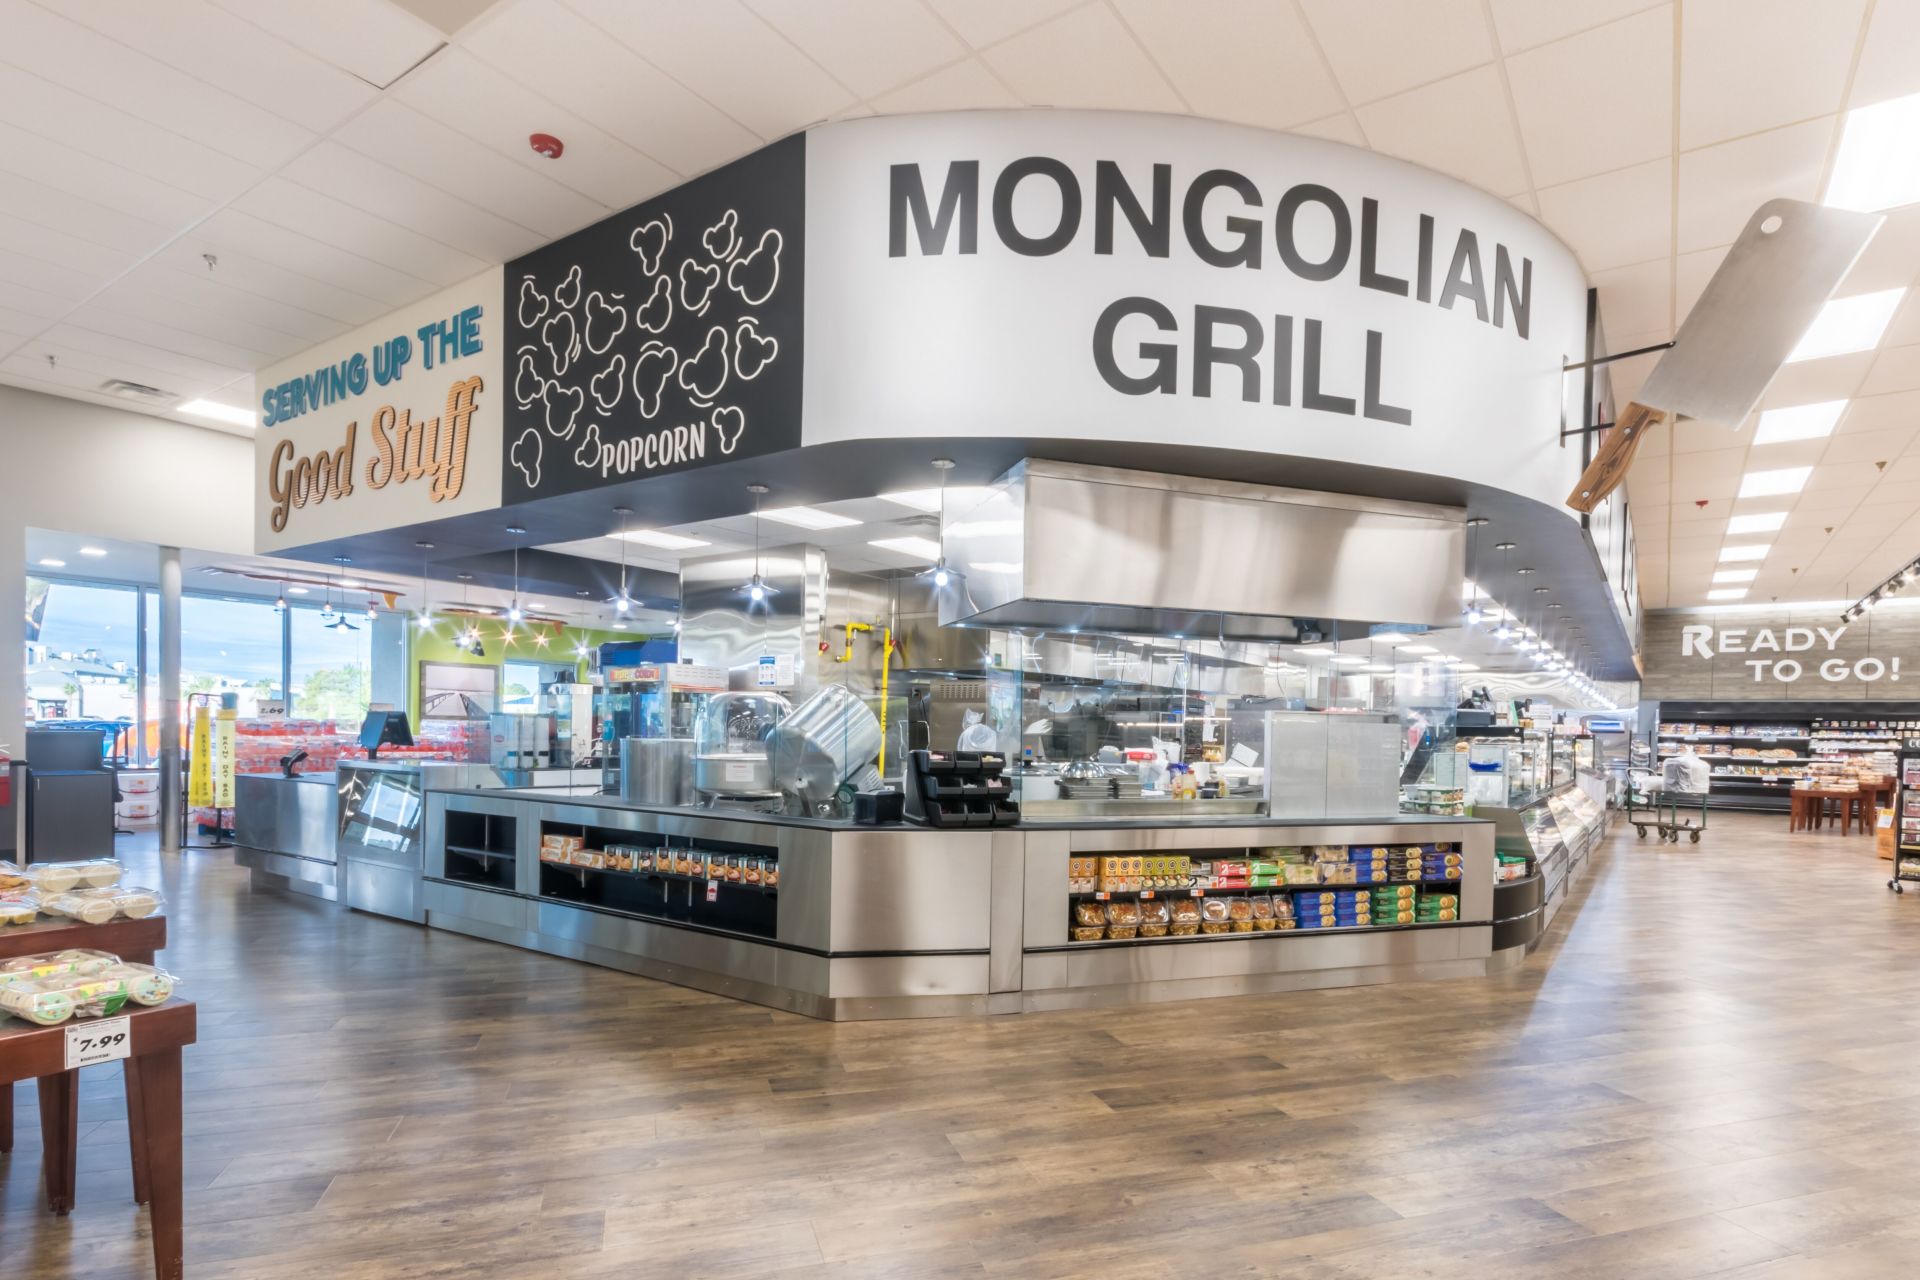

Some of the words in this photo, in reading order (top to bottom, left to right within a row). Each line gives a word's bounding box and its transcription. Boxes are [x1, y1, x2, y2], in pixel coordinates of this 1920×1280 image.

[888, 156, 1533, 341] MONGOLIAN
[262, 351, 369, 428] SERVING
[373, 334, 412, 386] UP
[417, 304, 484, 370] THE
[1092, 296, 1412, 427] GRILL
[269, 420, 357, 533] Good
[365, 375, 484, 503] Stuff
[600, 420, 707, 479] POPCORN
[1682, 625, 1847, 659] READY
[1745, 659, 1802, 682] TO
[1819, 657, 1900, 681] GO!
[79, 1032, 126, 1053] 7.99
